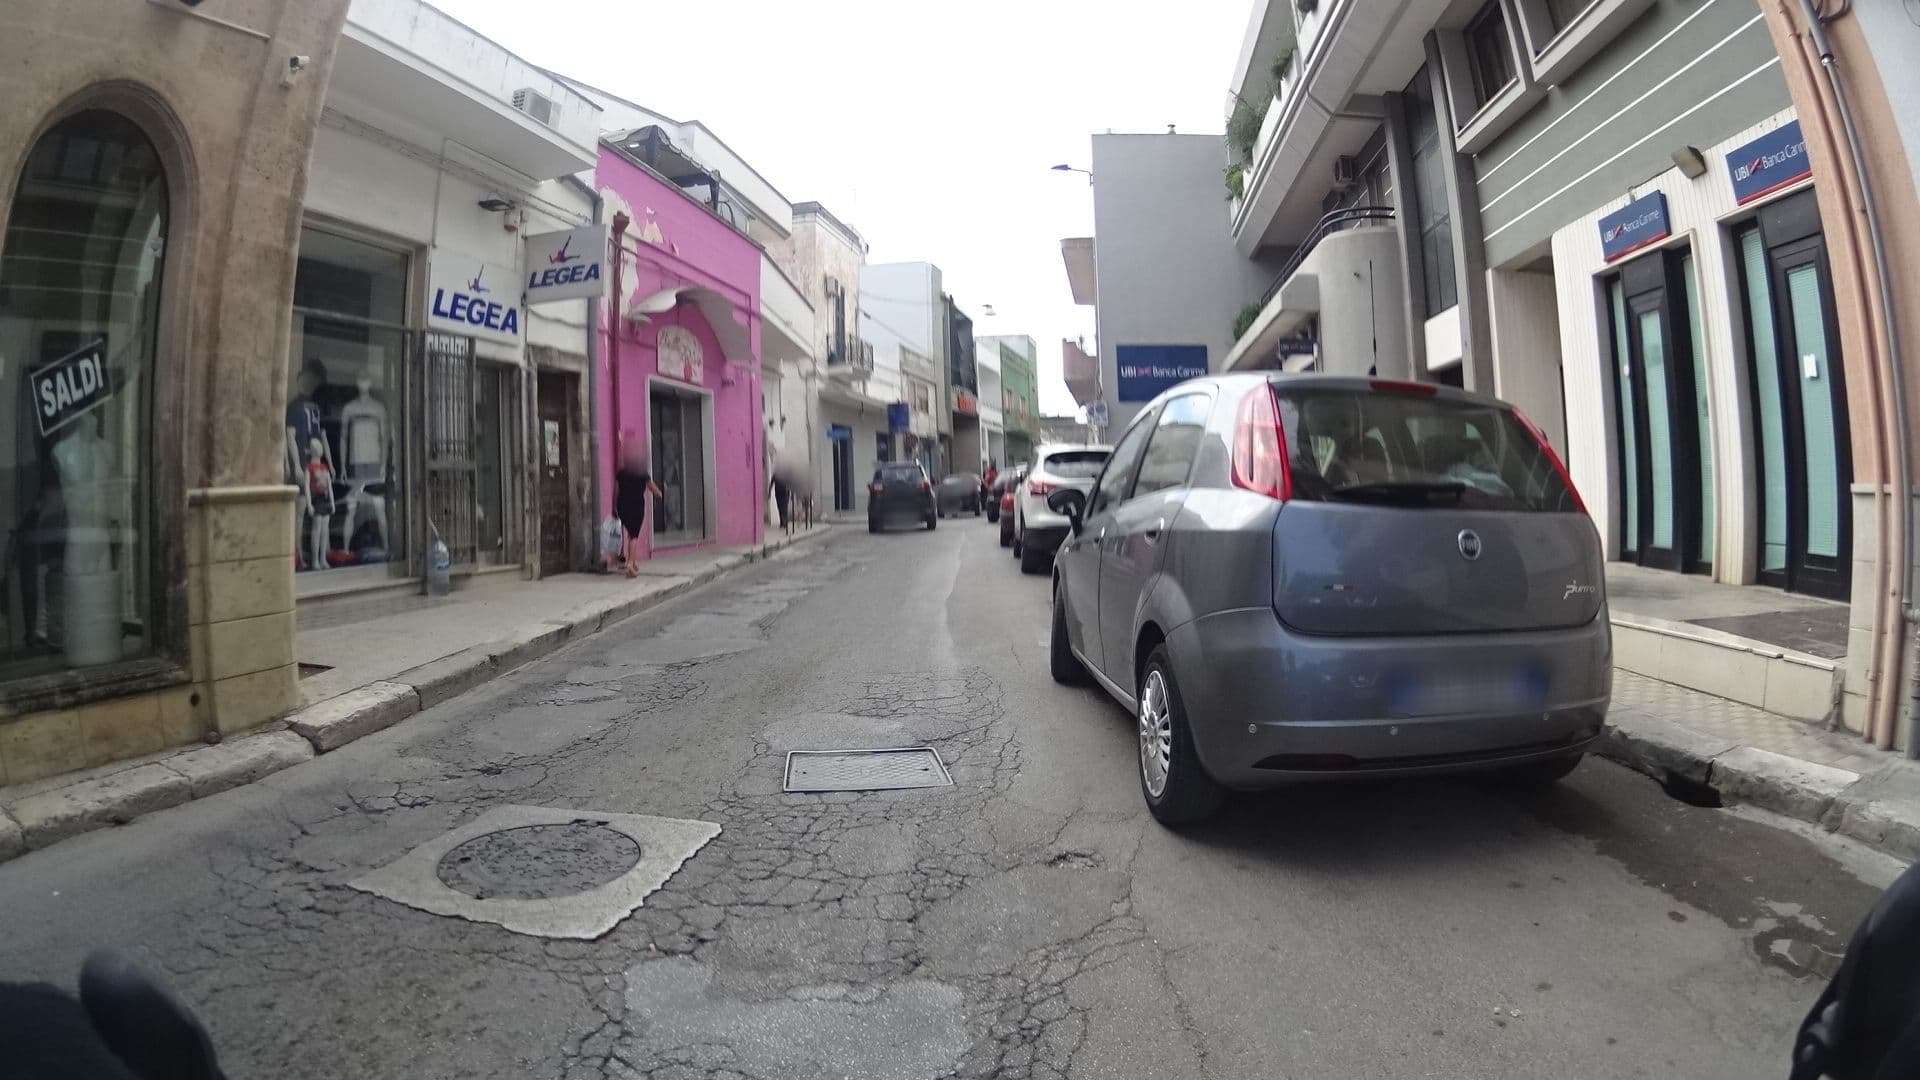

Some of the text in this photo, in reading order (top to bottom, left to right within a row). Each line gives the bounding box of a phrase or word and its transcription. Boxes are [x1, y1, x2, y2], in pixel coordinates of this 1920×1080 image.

[1735, 141, 1806, 181] UBI Banca Carim
[1604, 230, 1615, 243] UBI
[529, 264, 600, 289] LEGEA
[432, 288, 518, 335] LEGEA
[40, 352, 104, 417] SALDI
[1121, 365, 1206, 378] UBI Banca Carime
